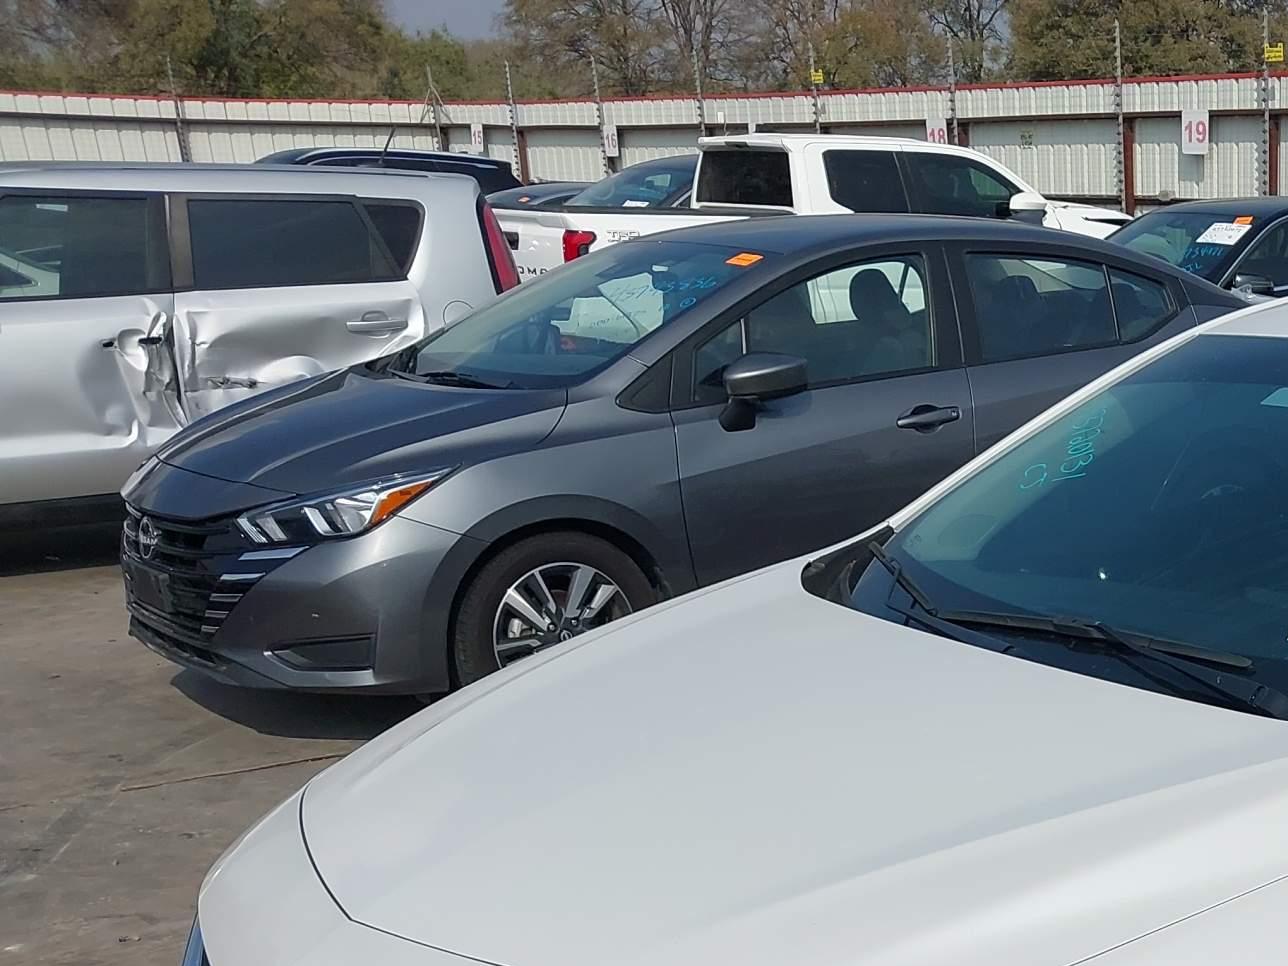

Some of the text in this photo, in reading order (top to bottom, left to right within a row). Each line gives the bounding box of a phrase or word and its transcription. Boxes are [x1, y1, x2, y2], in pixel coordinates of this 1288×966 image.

[472, 129, 482, 145] 15
[928, 127, 946, 145] 18
[1184, 119, 1208, 144] 19
[605, 133, 617, 149] 16
